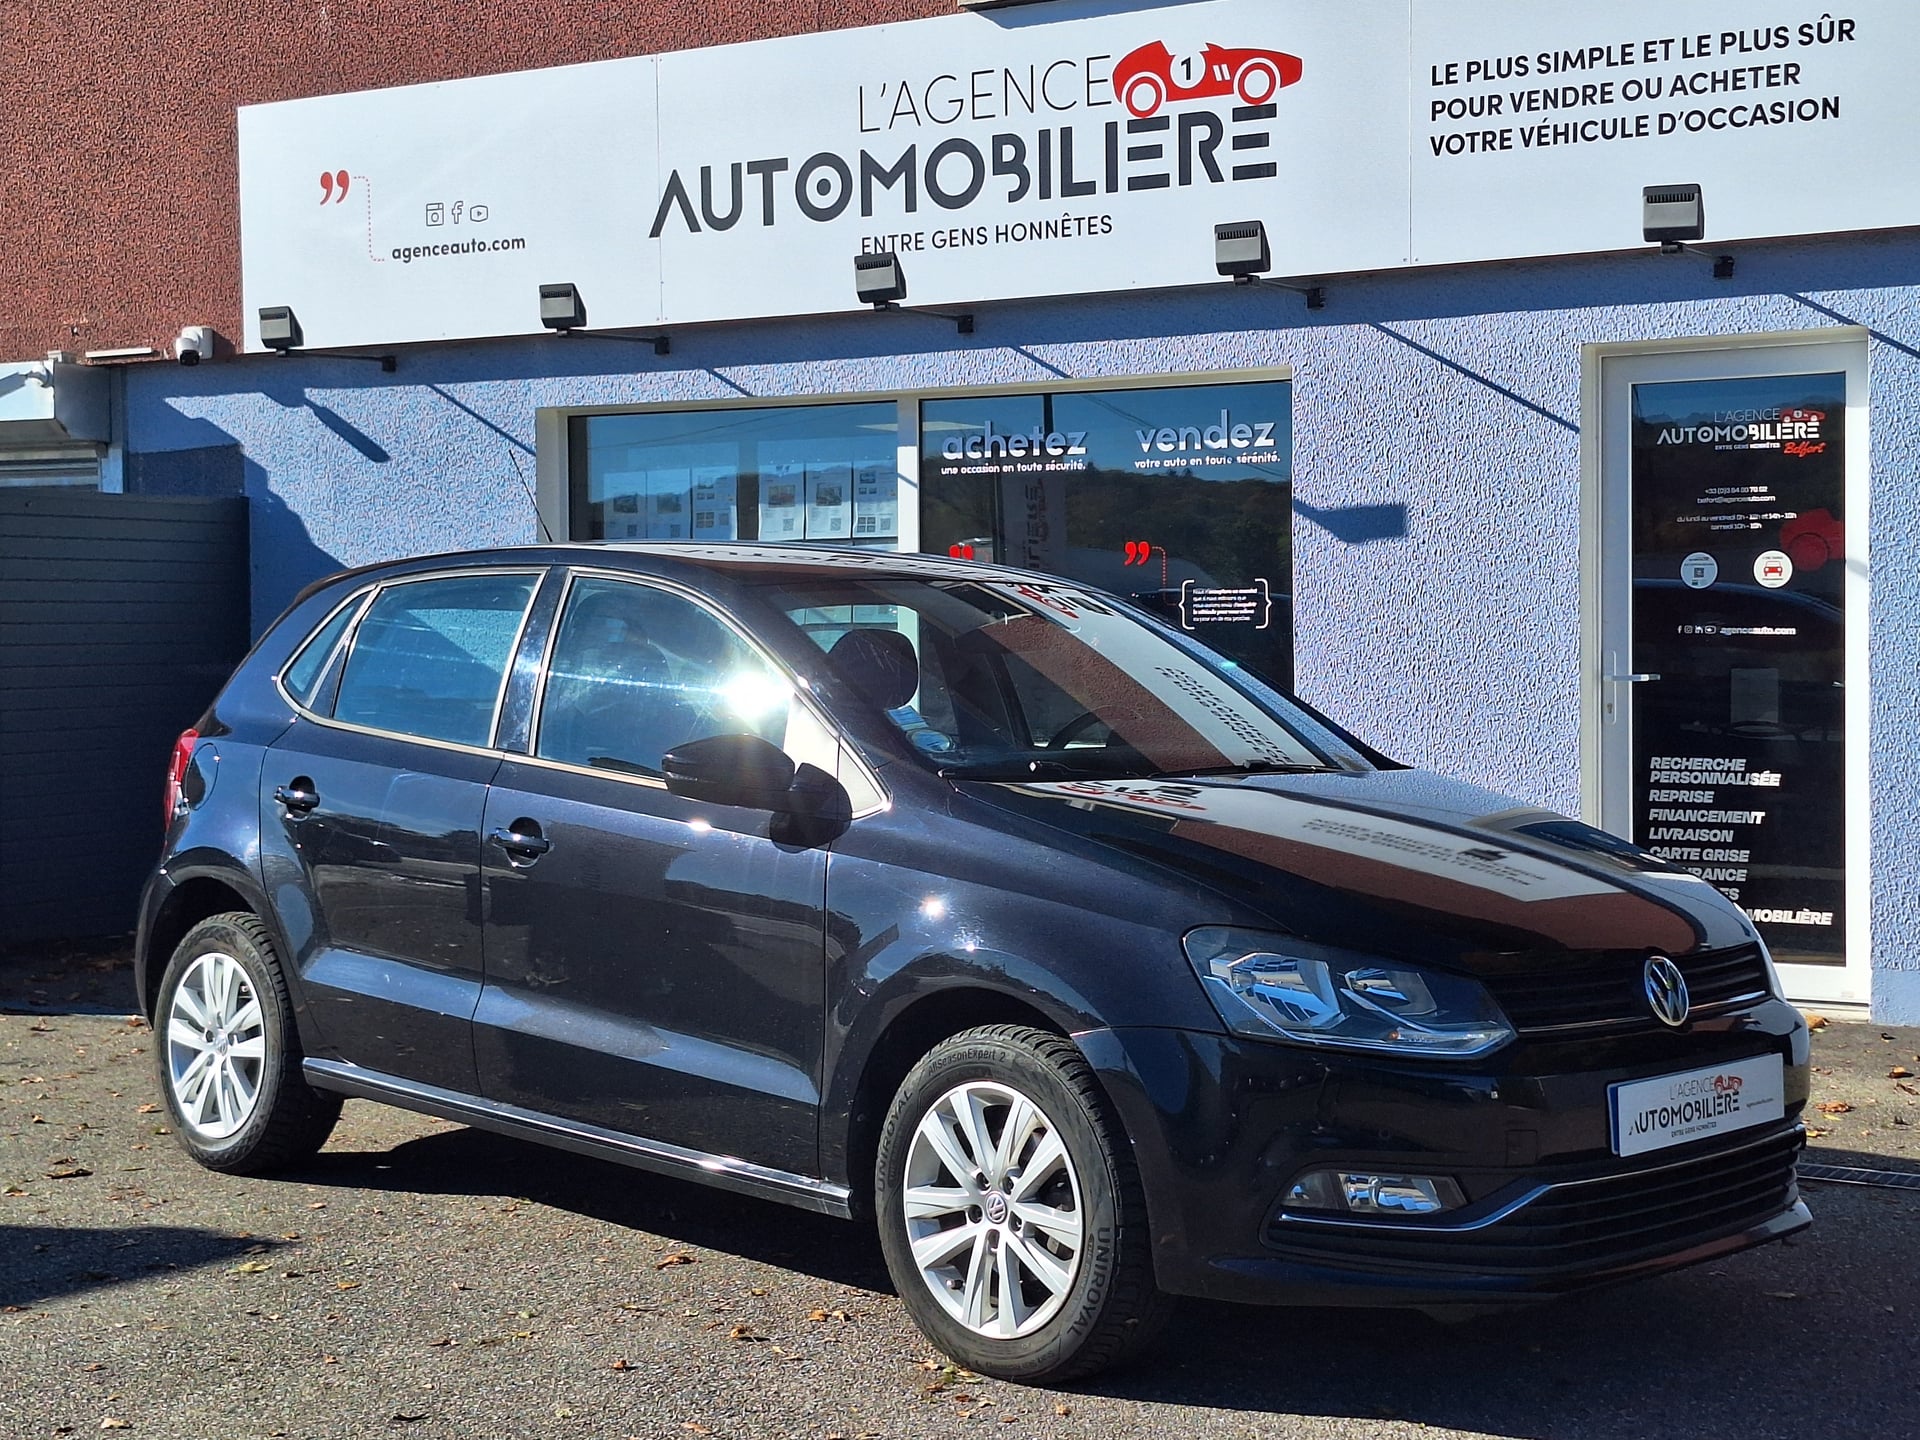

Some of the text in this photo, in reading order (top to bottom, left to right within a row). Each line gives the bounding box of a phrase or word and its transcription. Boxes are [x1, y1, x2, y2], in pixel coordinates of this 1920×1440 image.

[1431, 13, 1856, 87] LE PLUS SIMPLE ET LE PLUS SÛR
[858, 54, 1112, 133] L'AGENCE
[1431, 62, 1801, 122] POUR VENDRE OU ACHETER
[1430, 95, 1841, 157] VOTRE VÉHICULE D'OCCASION
[862, 212, 1114, 255] ENTRE GENS HONNÊTES
[392, 238, 526, 263] agenceauto.com
[1714, 407, 1781, 423] L'AGENCE
[941, 420, 1087, 460] achetez
[1135, 408, 1276, 453] vendez
[941, 458, 1086, 475] une occasion en toute sécurité.
[1134, 450, 1281, 468] votre auto en toute sérénité.
[1650, 756, 1747, 771] RECHERCHE
[1650, 770, 1782, 787] PERSONNALISÉE
[1648, 789, 1715, 803] REPRISE
[1648, 808, 1766, 825] FINANCEMENT
[1648, 827, 1734, 842] LIVRAISON
[1650, 846, 1750, 863] CARTE GRISE
[877, 1090, 913, 1192] UNIROYAL
[1067, 1227, 1111, 1336] UNIROYAL
